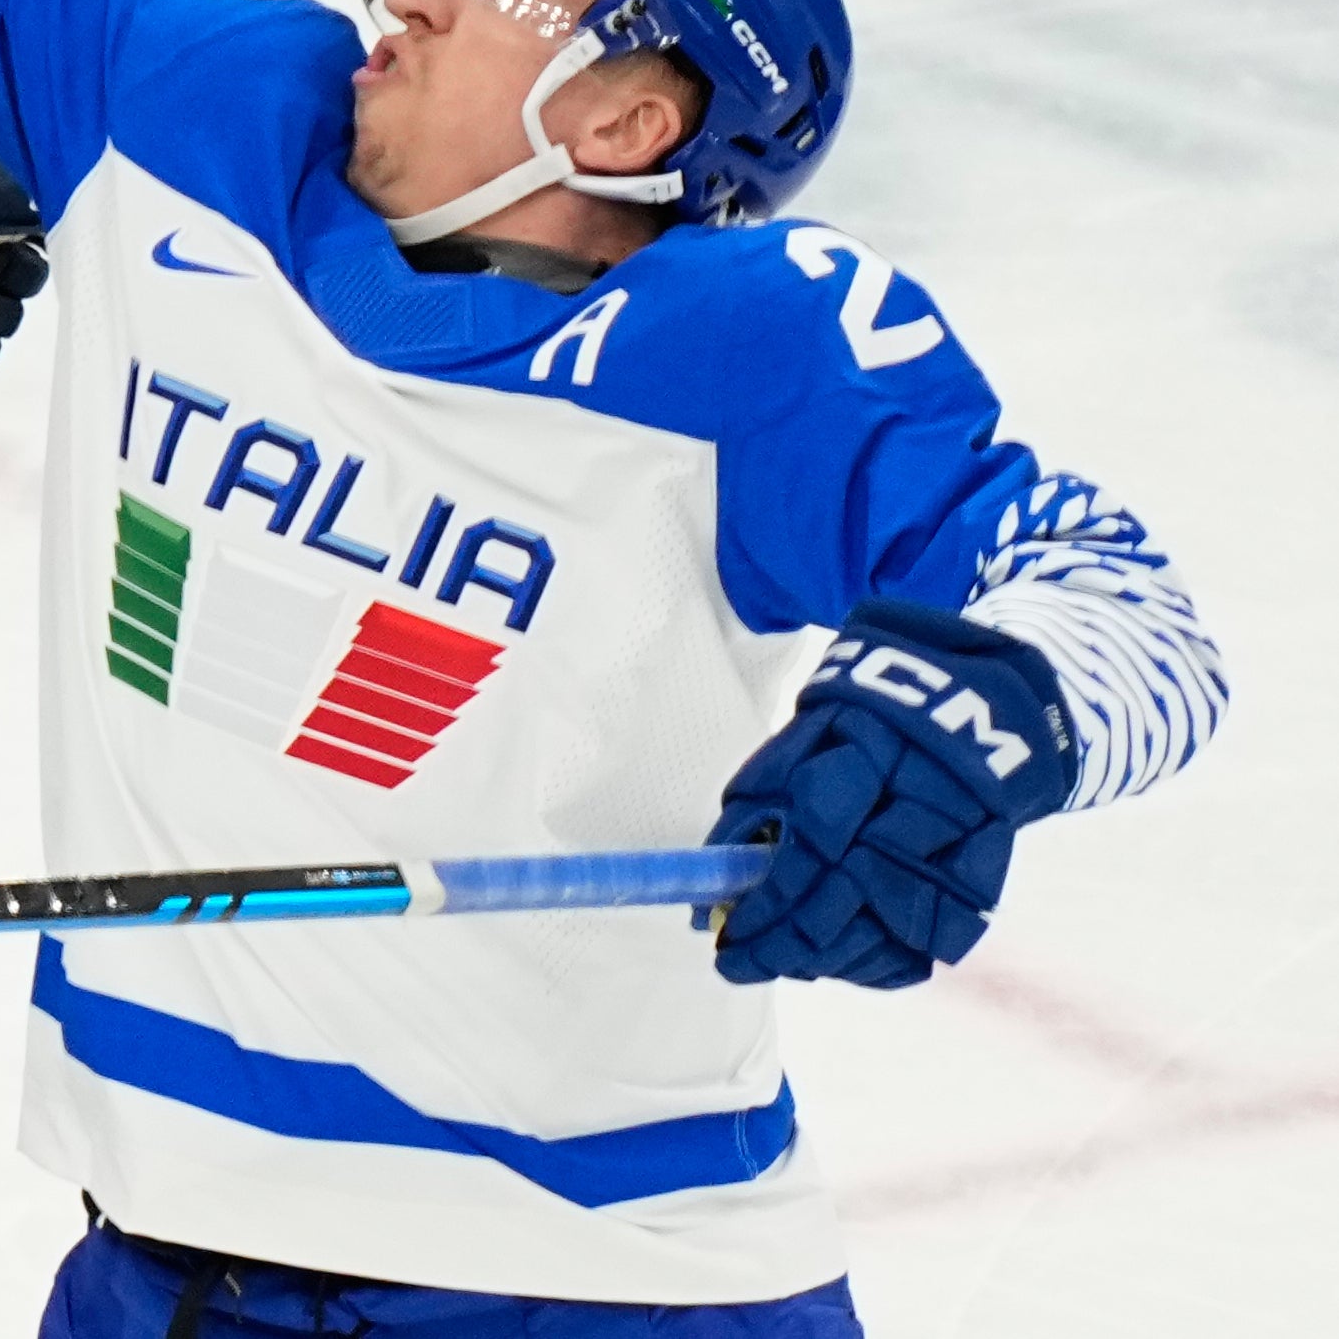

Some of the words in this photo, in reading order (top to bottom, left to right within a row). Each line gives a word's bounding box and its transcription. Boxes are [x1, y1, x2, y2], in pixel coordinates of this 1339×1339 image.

[731, 19, 789, 94] CCM
[528, 288, 628, 386] A
[786, 226, 945, 371] 2
[119, 356, 556, 633] ITALIA
